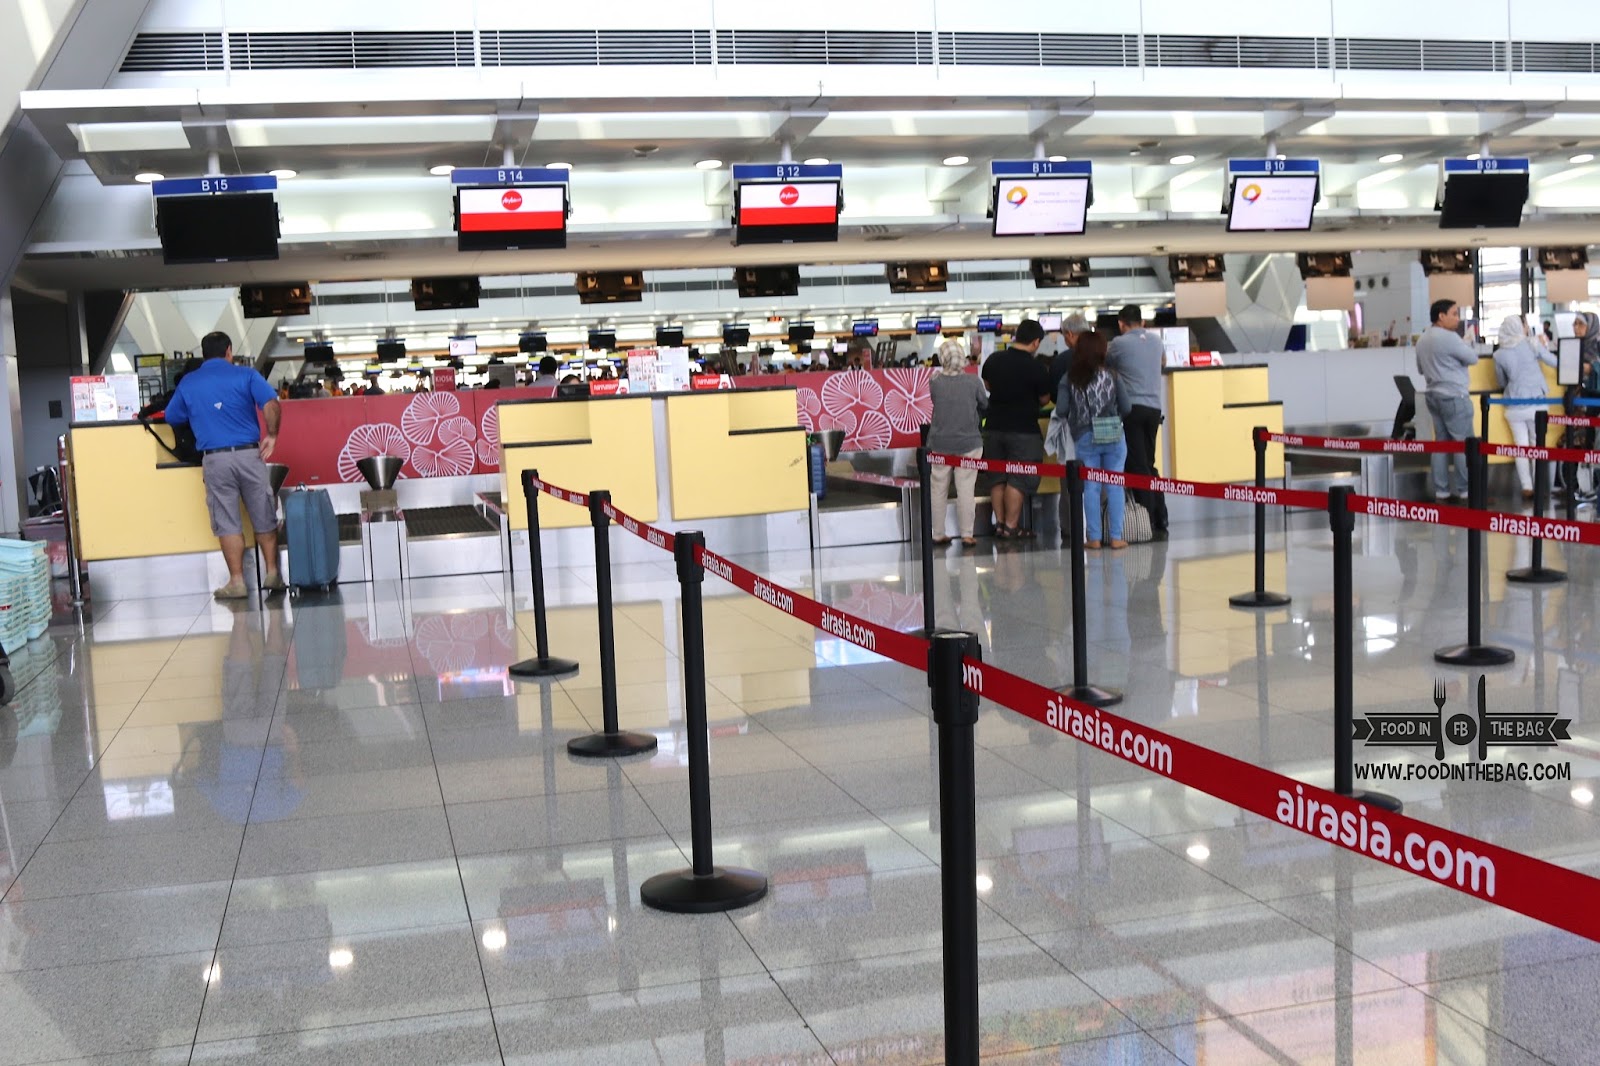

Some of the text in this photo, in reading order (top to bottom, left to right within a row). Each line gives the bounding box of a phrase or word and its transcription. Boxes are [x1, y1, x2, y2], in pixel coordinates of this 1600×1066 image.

[1032, 162, 1052, 173] B 11
[1265, 161, 1285, 171] B 10
[1477, 160, 1498, 170] B 09
[498, 170, 523, 181] B 14
[776, 166, 800, 177] B 12
[201, 179, 228, 191] B 15
[435, 375, 453, 383] KIOSK
[1548, 416, 1590, 426] airasia.com
[1271, 434, 1424, 452] airasia.com airasia.com airasia.com
[1496, 445, 1548, 460] airasia.com
[960, 458, 988, 470] airasia.com
[1005, 462, 1037, 475] airasia.com
[1087, 469, 1277, 504] airasia.com airasia.com airasia.com
[1367, 498, 1581, 542] airasia.com airasia.com
[701, 550, 876, 651] airasia.com airasia.com airasia.com
[1046, 696, 1496, 898] airasia.com airasia.com
